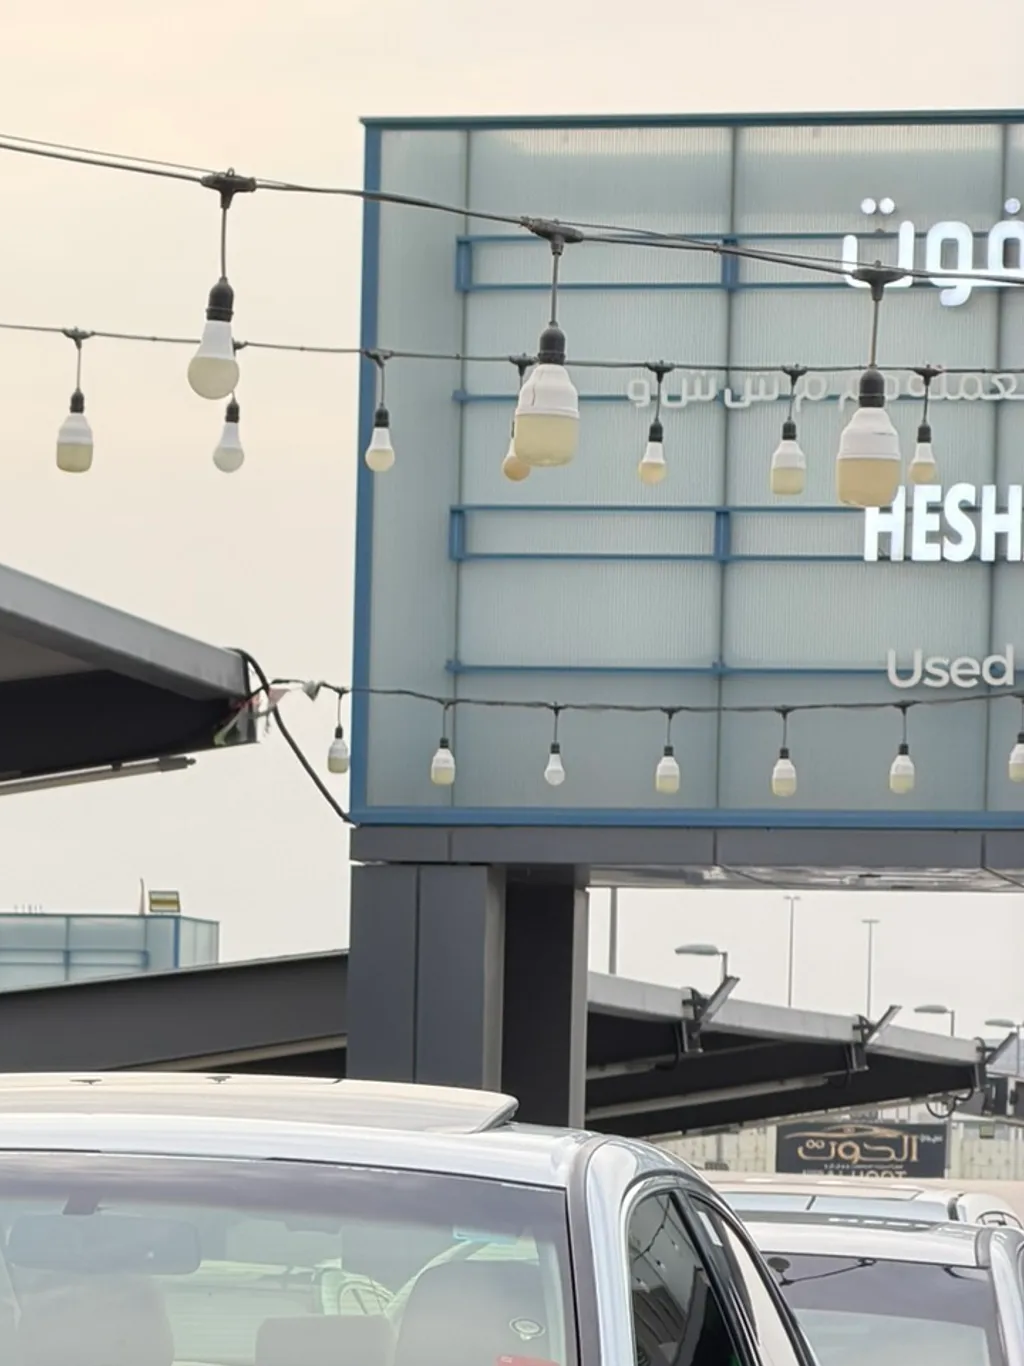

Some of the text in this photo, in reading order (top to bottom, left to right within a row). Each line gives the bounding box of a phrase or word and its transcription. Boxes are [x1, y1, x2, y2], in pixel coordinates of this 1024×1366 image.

[841, 196, 1024, 307] فوت
[864, 482, 1024, 562] HESH
[887, 643, 1015, 688] Used
